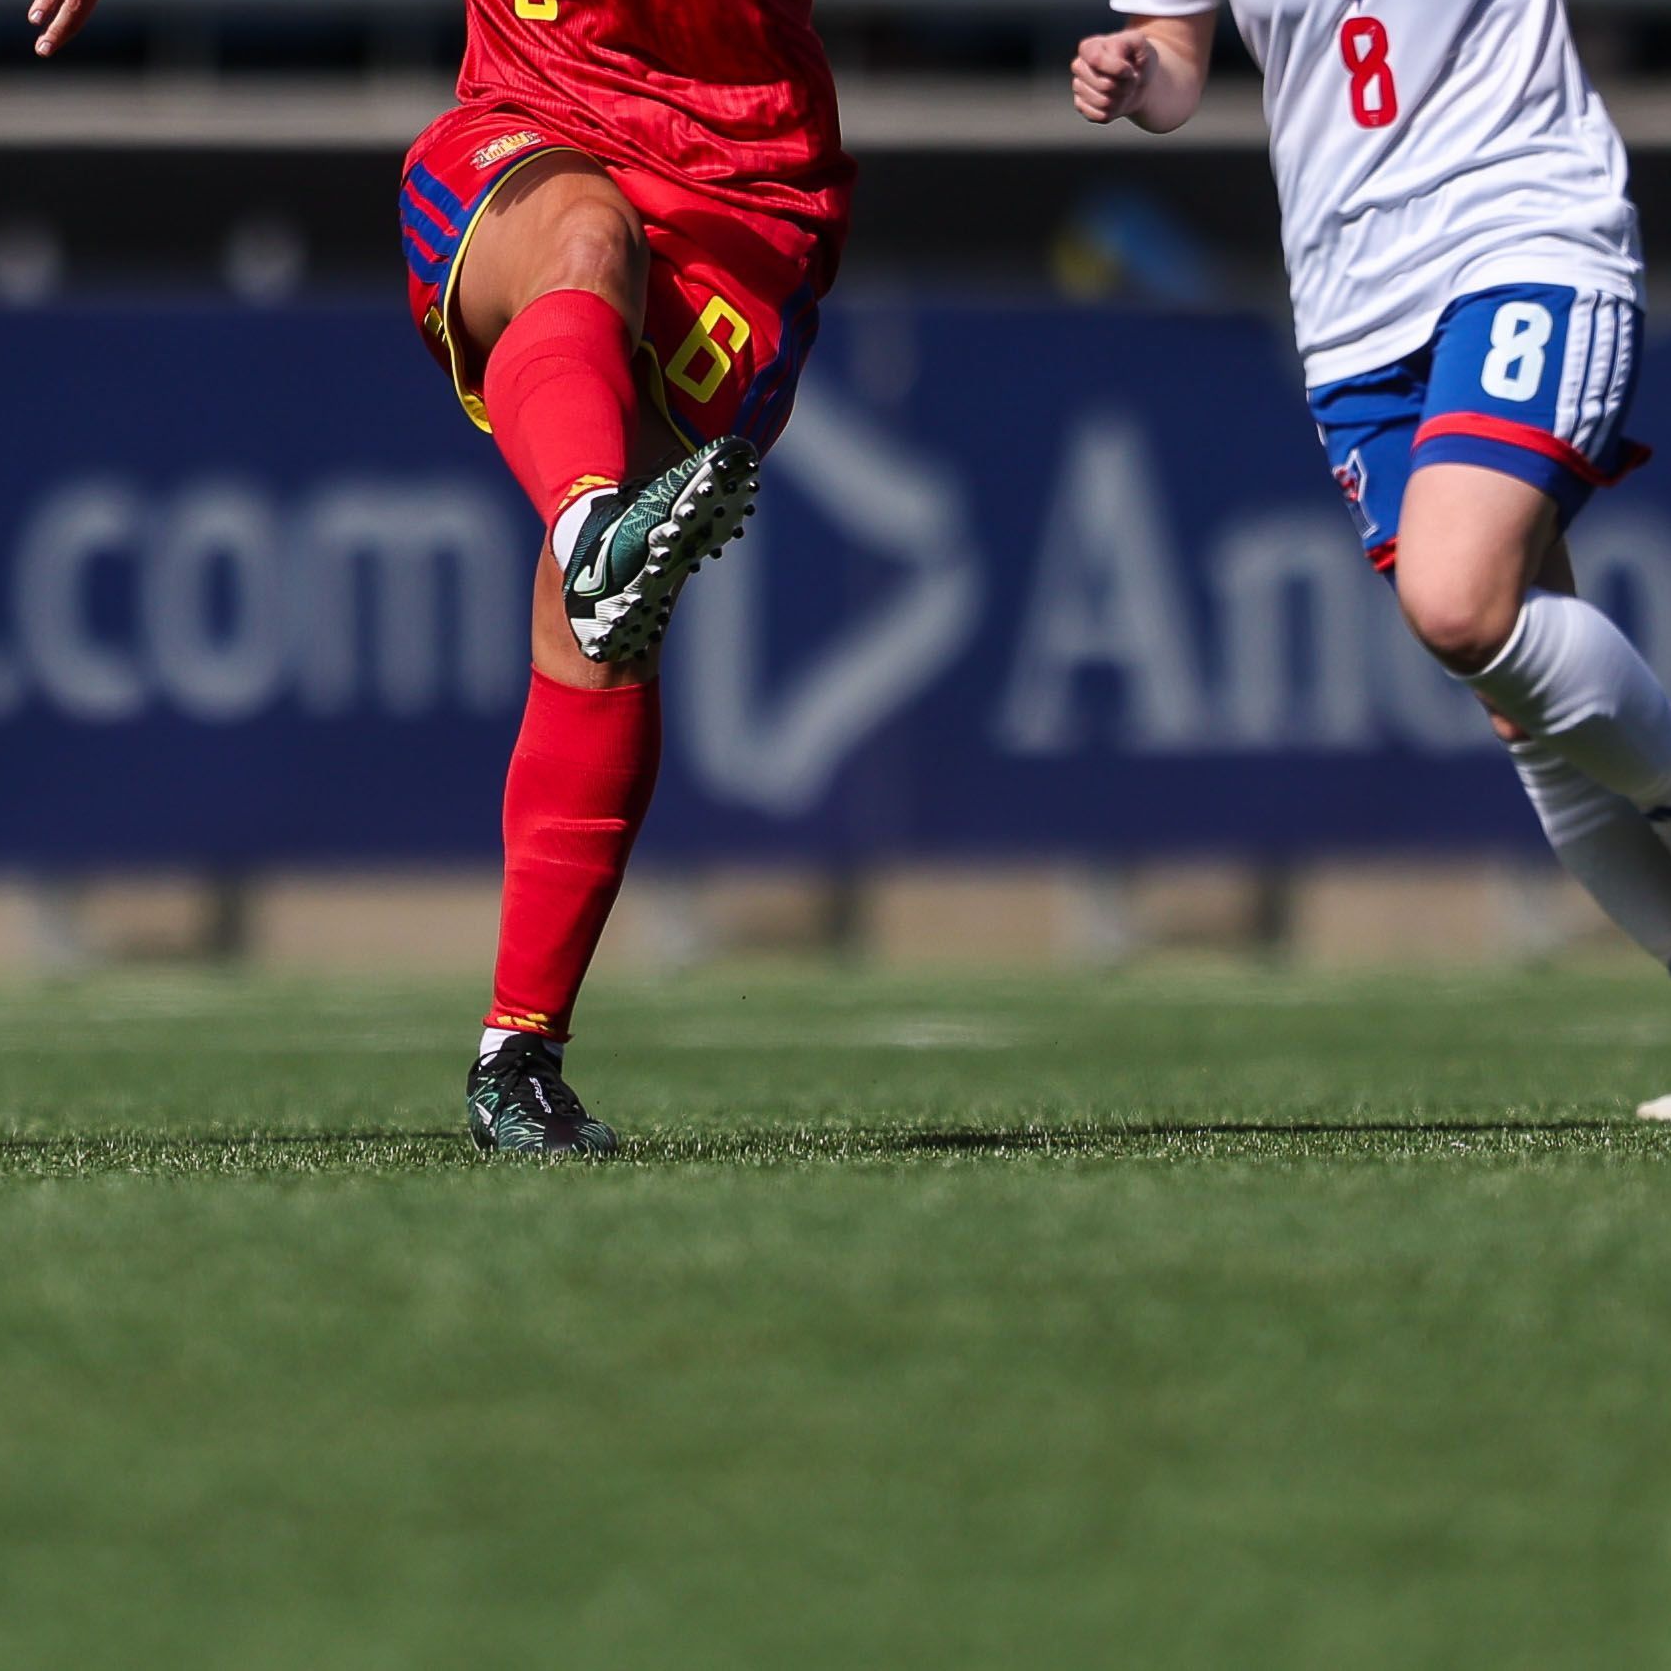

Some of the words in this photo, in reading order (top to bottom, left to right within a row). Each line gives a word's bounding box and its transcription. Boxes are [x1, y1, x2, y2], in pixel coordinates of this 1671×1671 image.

[1340, 16, 1398, 129] 8
[665, 294, 750, 403] 6
[1480, 300, 1553, 403] 8
